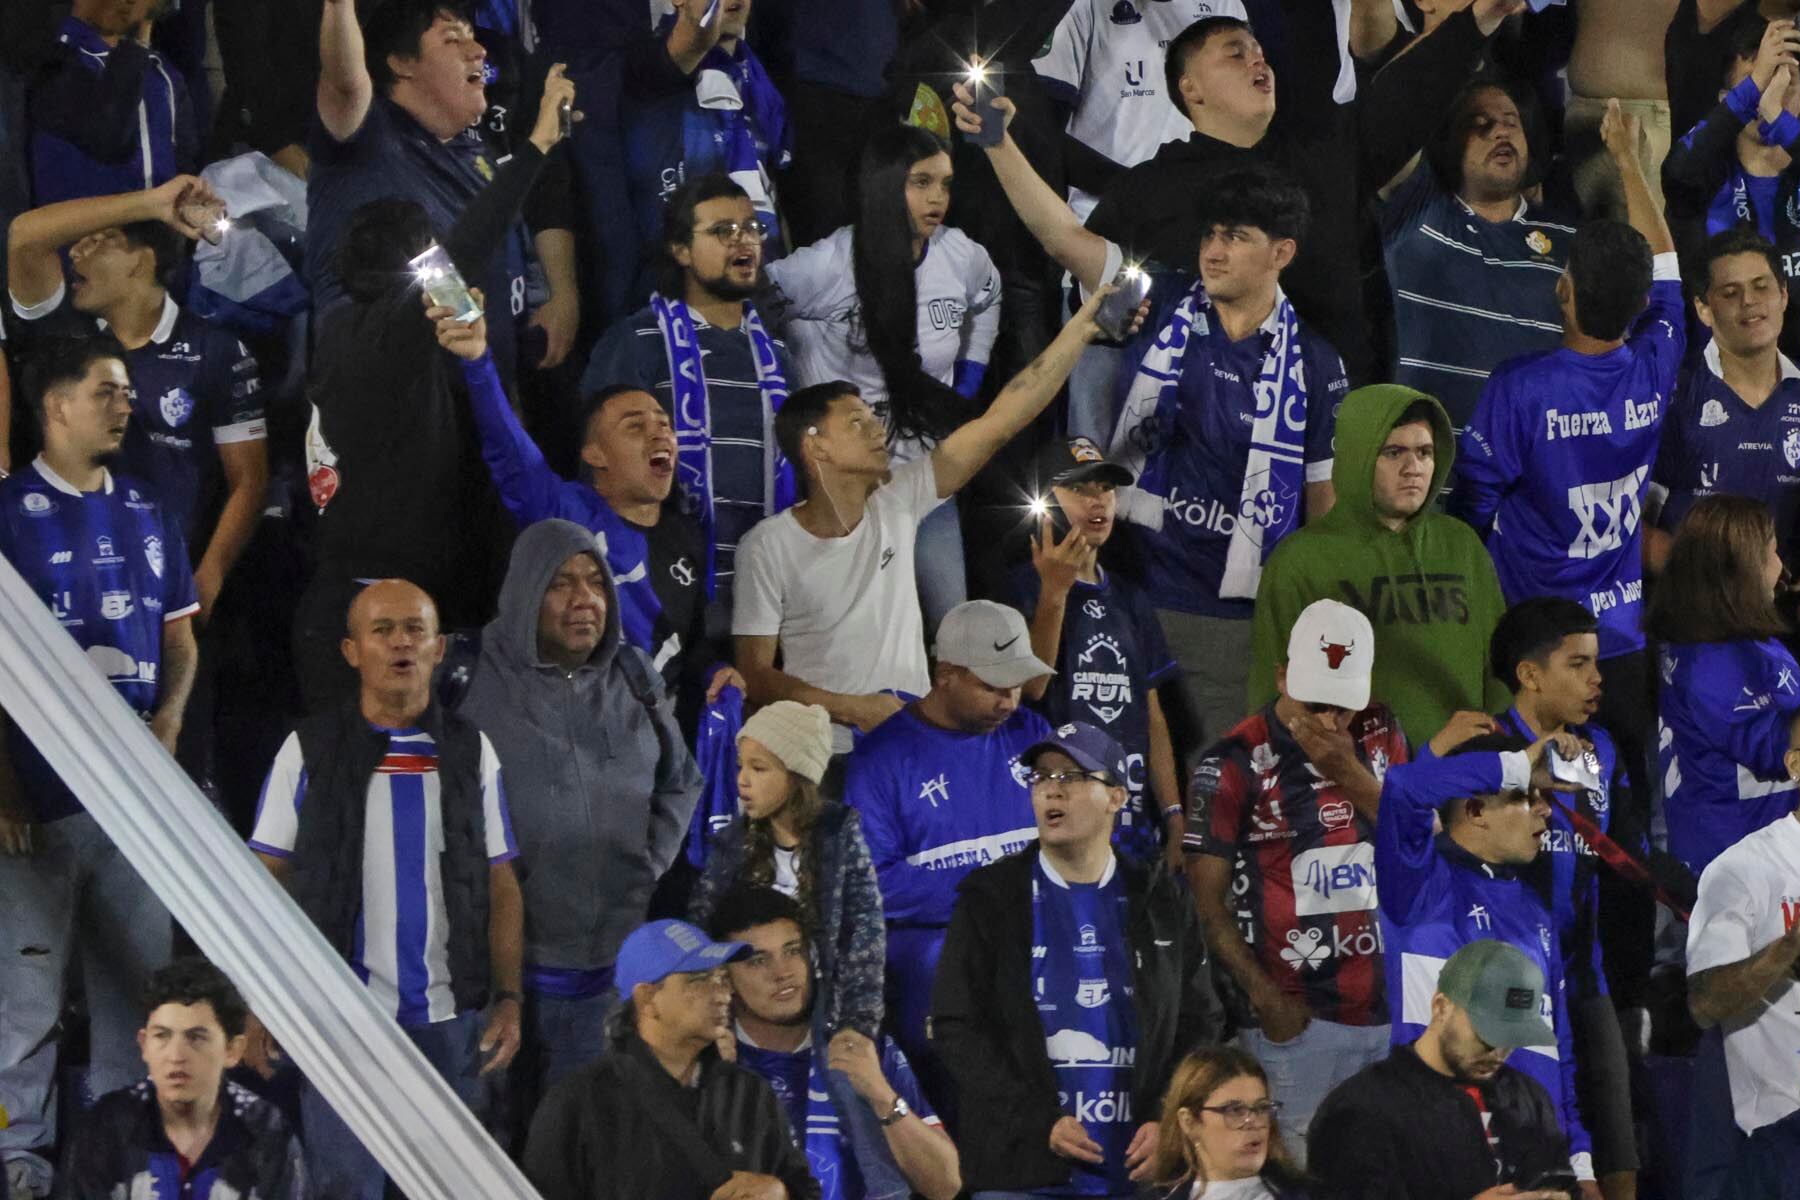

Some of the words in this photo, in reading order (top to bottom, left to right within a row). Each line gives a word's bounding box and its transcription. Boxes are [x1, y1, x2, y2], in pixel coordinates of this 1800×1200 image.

[1121, 89, 1132, 98] San
[1133, 88, 1155, 97] Marcos
[1546, 409, 1612, 440] Fuerza
[1738, 442, 1772, 450] ATREVIA
[1340, 572, 1470, 626] VANS
[1072, 686, 1132, 703] RUN
[1332, 861, 1375, 893] BN
[1112, 1047, 1135, 1064] IN
